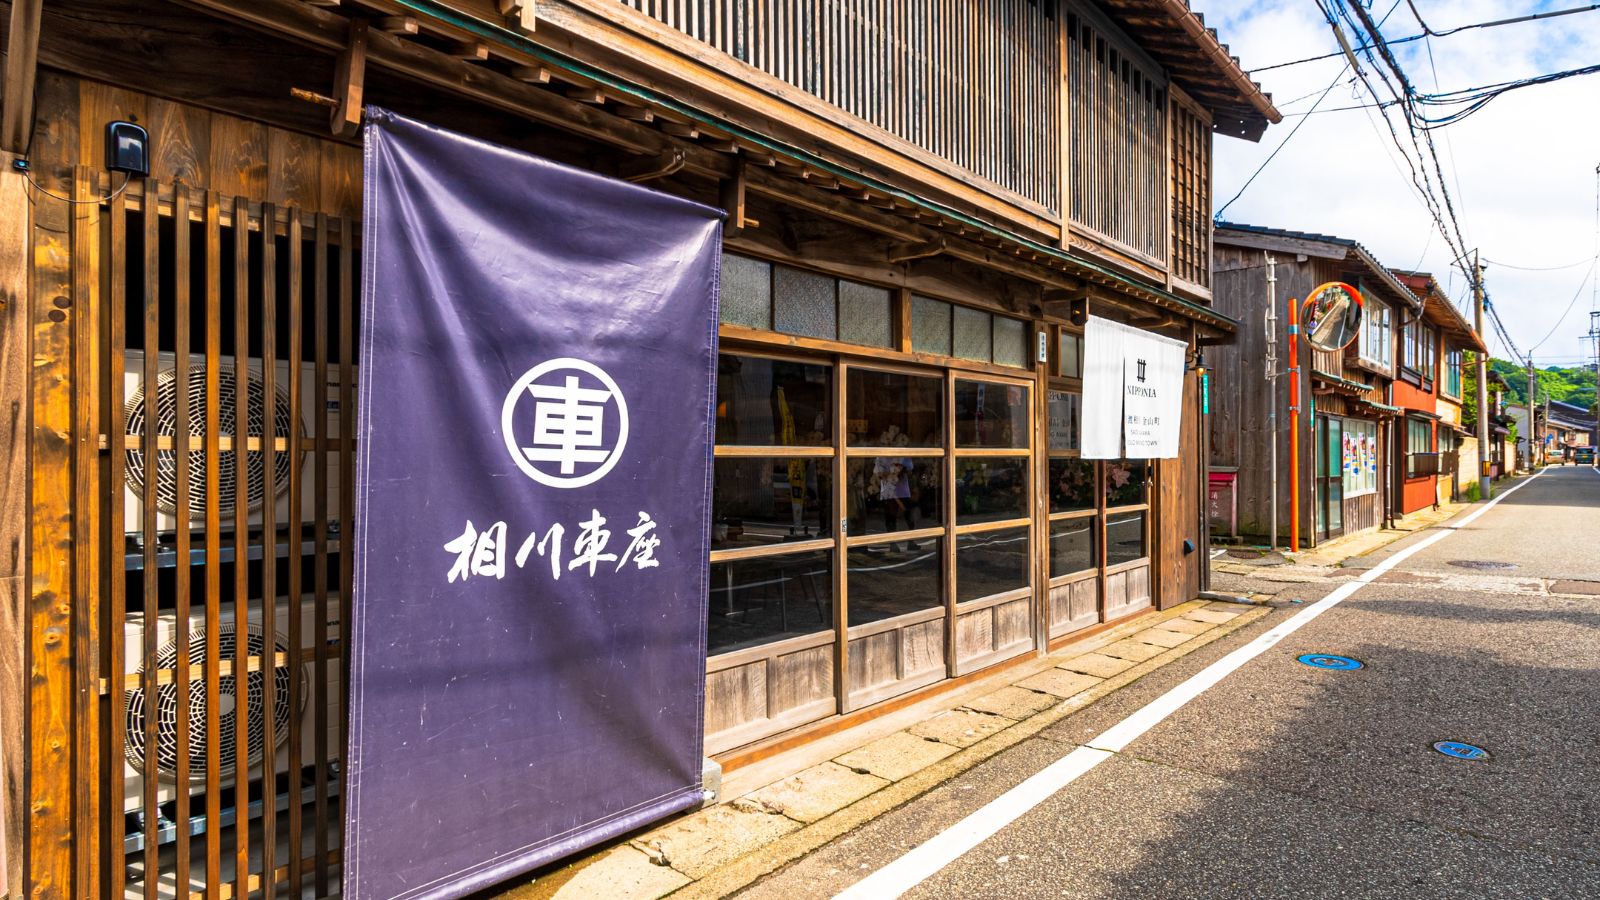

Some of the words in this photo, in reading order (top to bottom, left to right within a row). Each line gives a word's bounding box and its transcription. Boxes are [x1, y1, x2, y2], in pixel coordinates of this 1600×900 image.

[521, 375, 613, 474] 車
[1127, 385, 1157, 398] NIPPONIA
[443, 508, 661, 584] 相川車座
